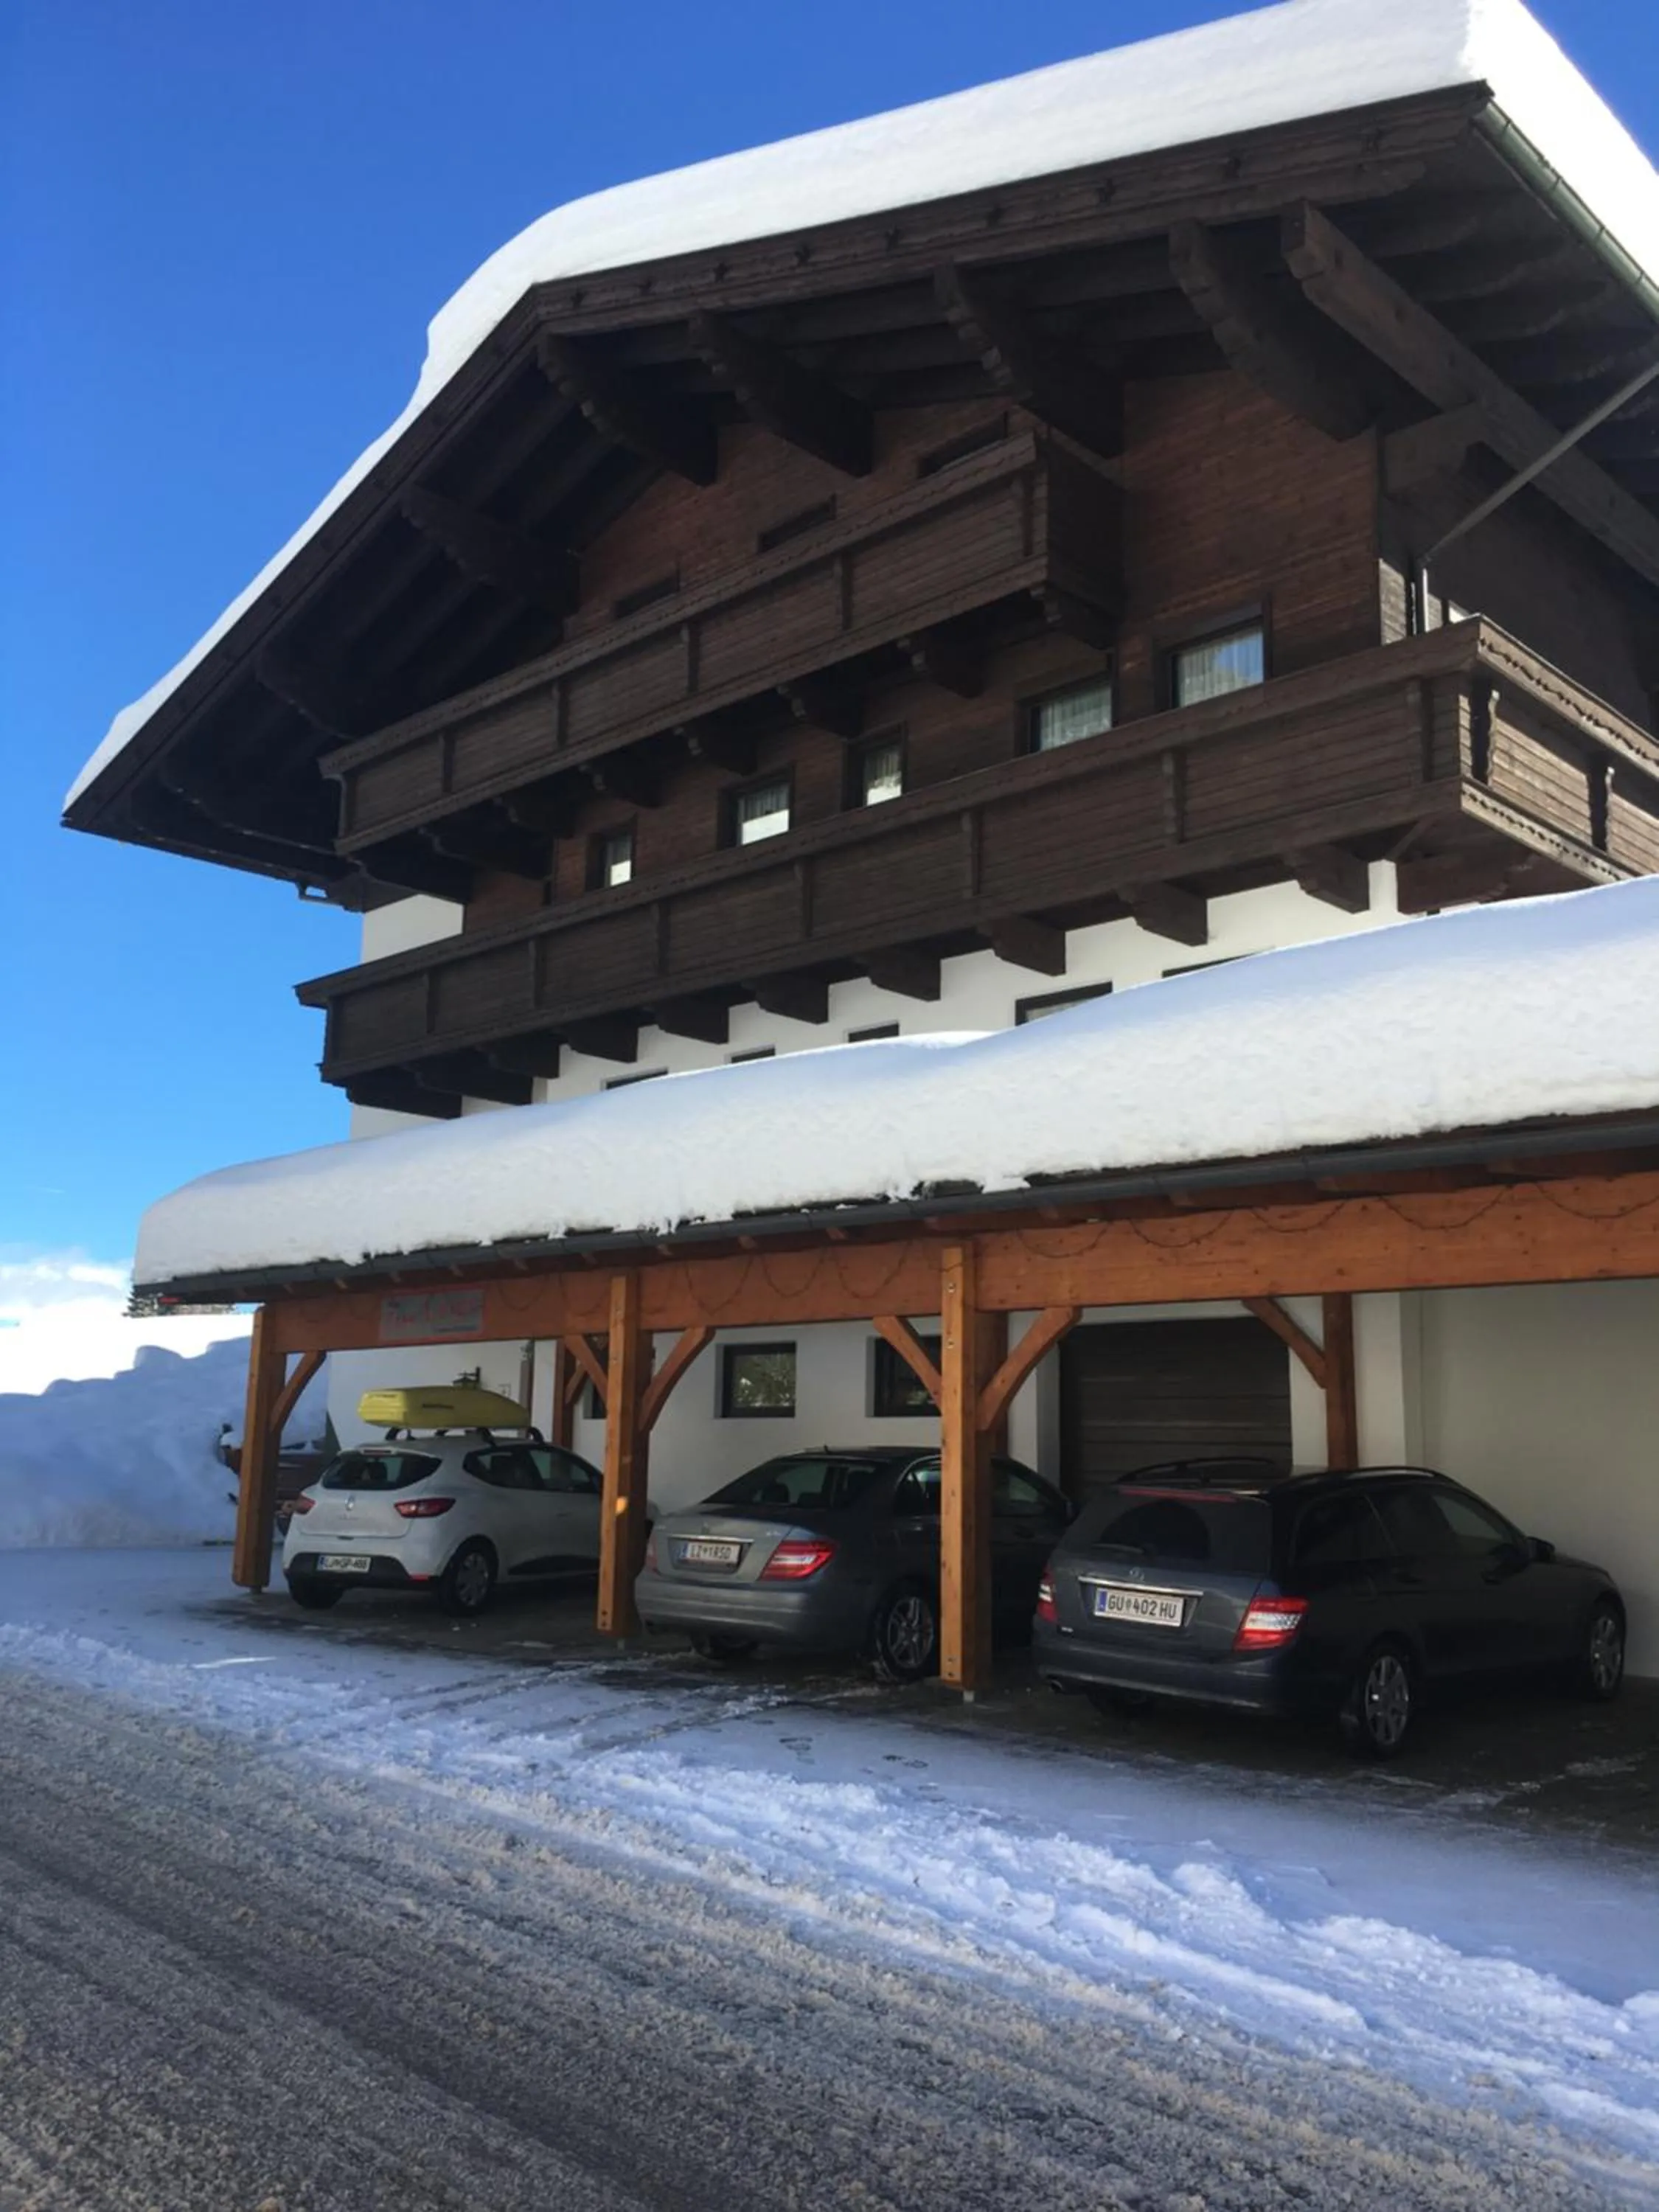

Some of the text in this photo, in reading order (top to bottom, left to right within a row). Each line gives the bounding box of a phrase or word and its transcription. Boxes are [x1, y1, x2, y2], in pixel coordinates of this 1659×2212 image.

[1108, 1594, 1178, 1618] GU 402 HU
